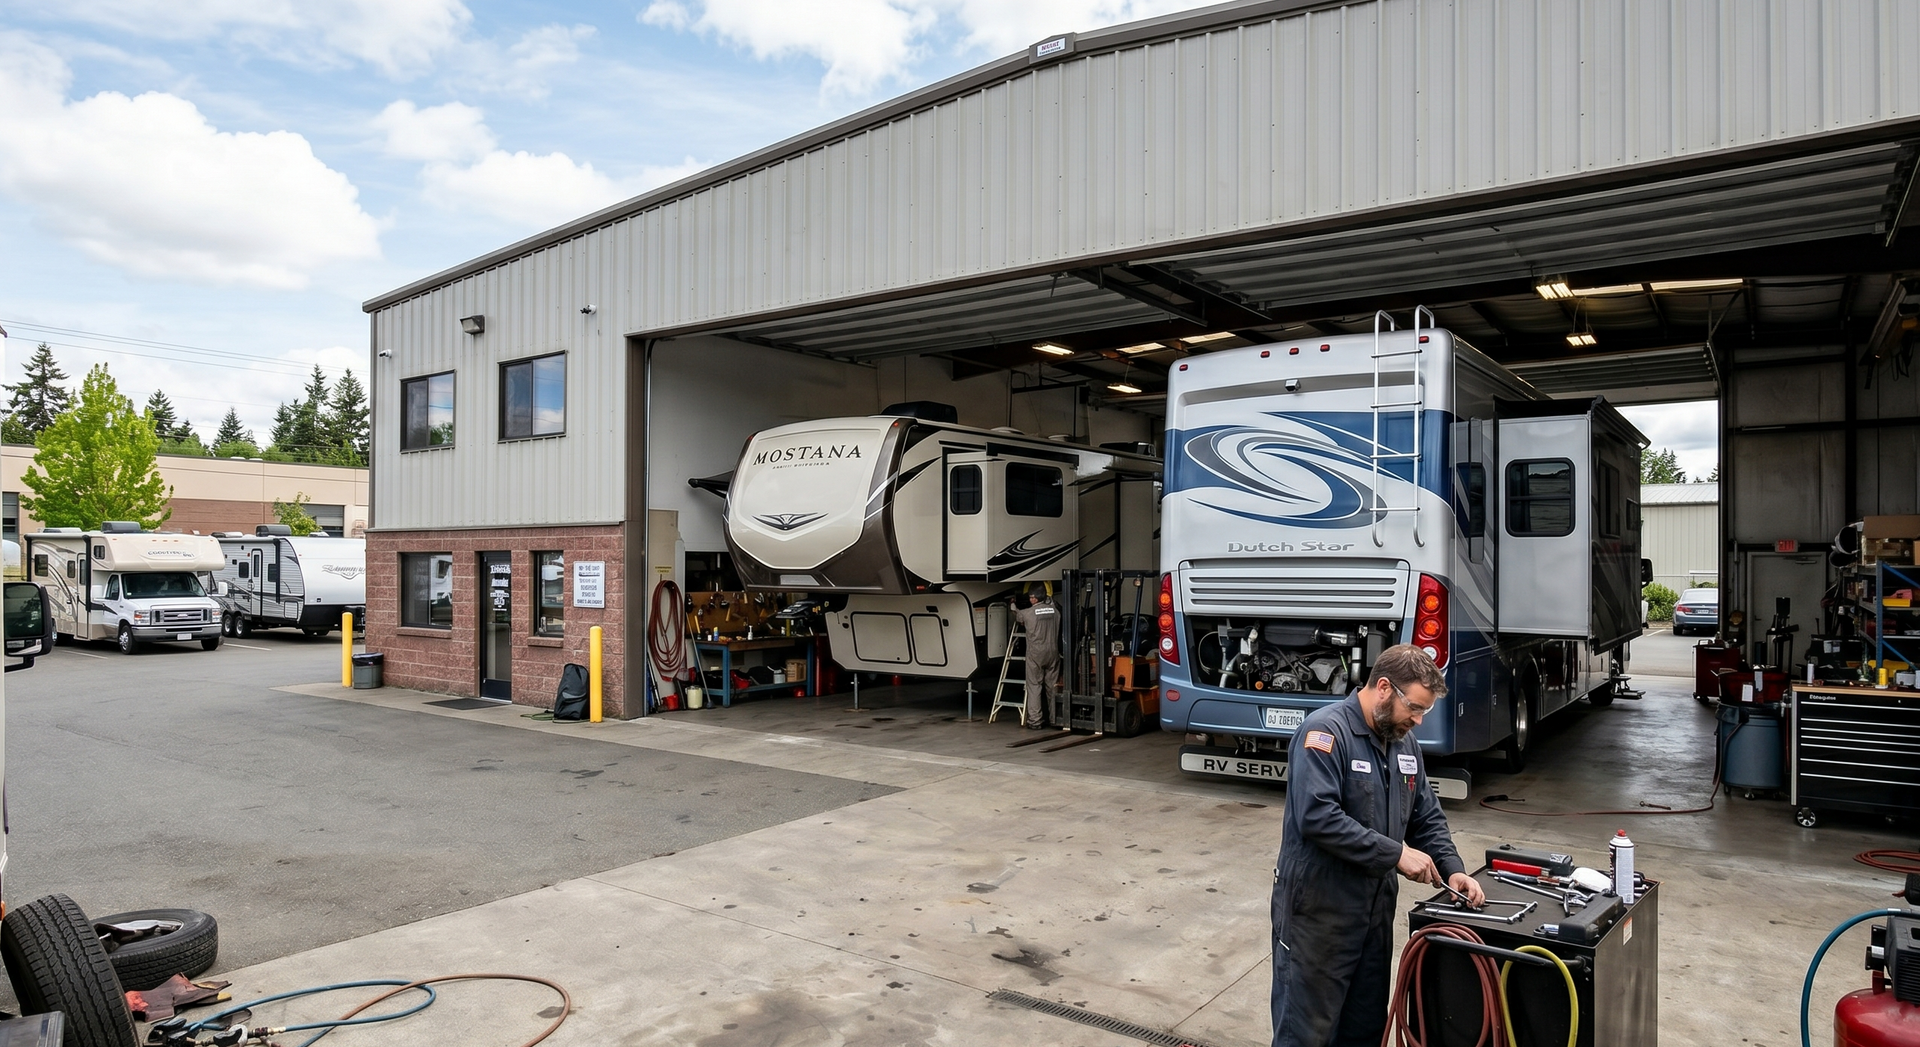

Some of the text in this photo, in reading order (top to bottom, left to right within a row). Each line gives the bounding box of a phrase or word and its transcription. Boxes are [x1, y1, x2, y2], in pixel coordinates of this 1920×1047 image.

[752, 444, 862, 466] MOSTANA
[1228, 540, 1355, 553] Dutch Star
[1203, 758, 1229, 772] RV
